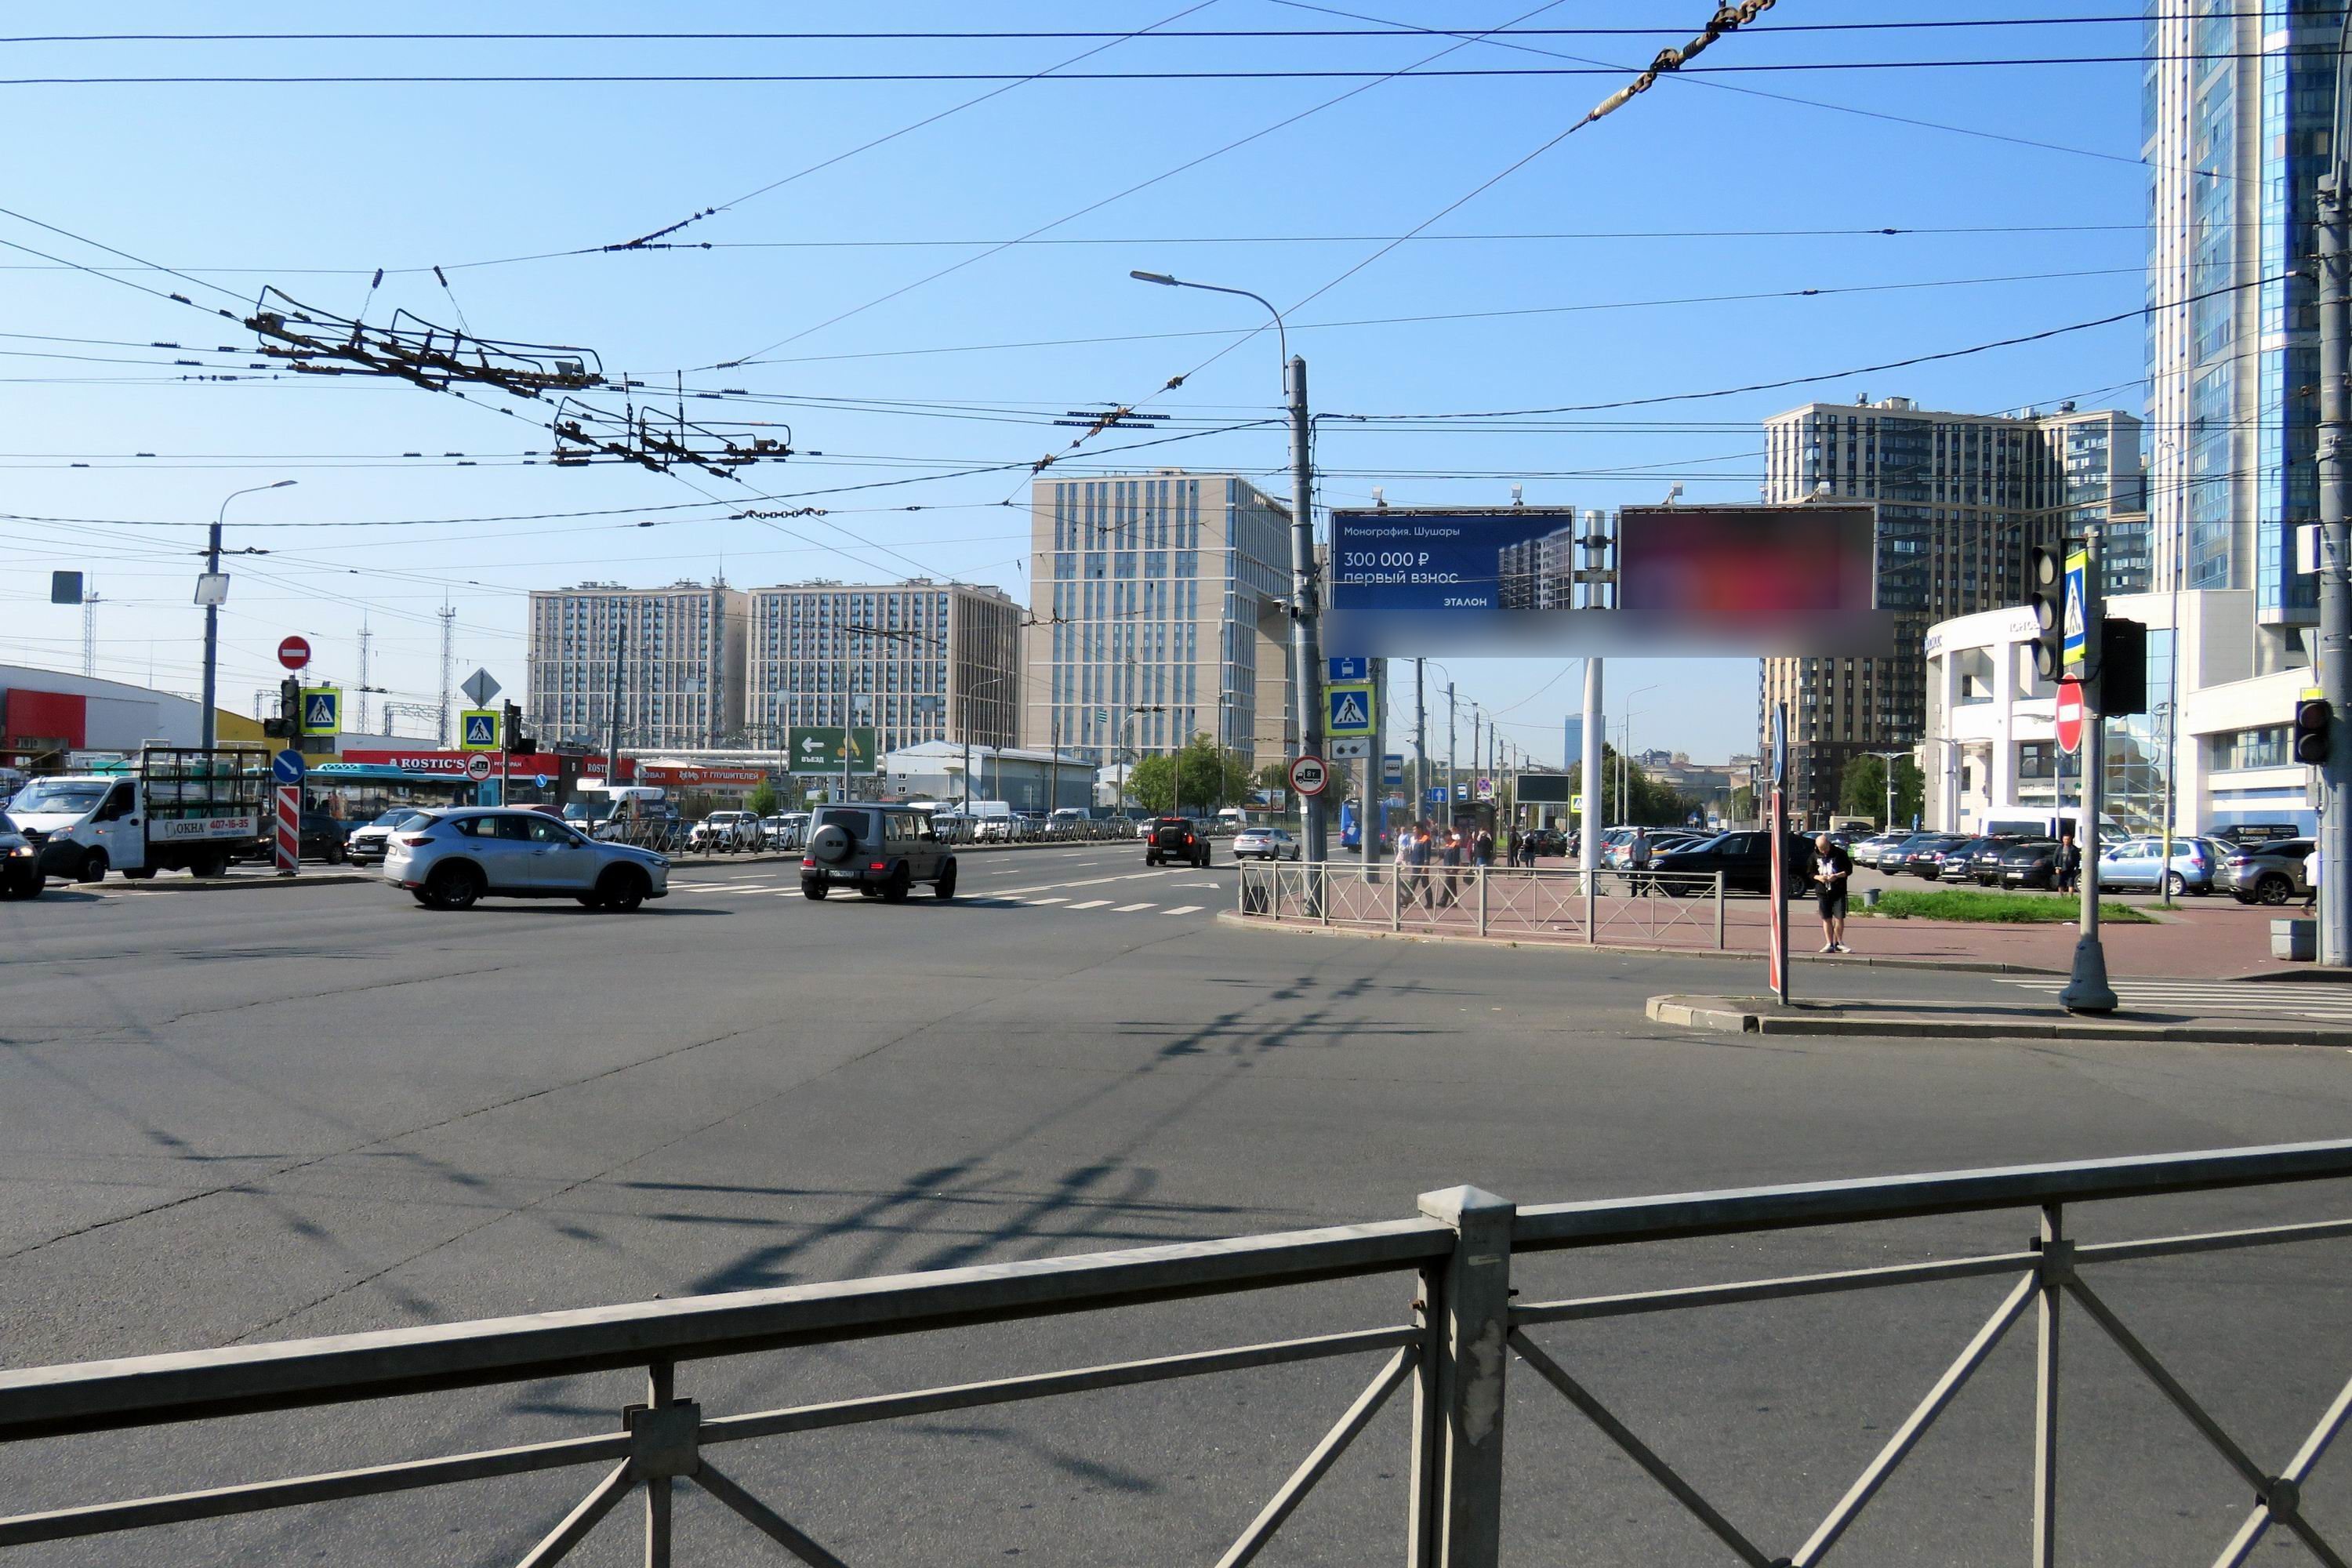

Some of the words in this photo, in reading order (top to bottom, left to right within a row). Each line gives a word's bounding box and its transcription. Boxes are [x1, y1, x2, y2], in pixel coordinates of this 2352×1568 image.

[1344, 526, 1412, 538] Монография.
[1414, 526, 1461, 538] Шушары
[1344, 552, 1376, 567] 300
[1380, 552, 1414, 567] 000
[1344, 570, 1406, 586] первый
[1410, 572, 1459, 584] взнос
[1443, 597, 1487, 607] ЭТАЛОН
[401, 758, 466, 769] ROSTIC'S
[710, 771, 759, 780] ГЛУШИТЕЛЕЙ
[176, 822, 205, 834] ОКНА
[209, 818, 249, 829] 407-16-35
